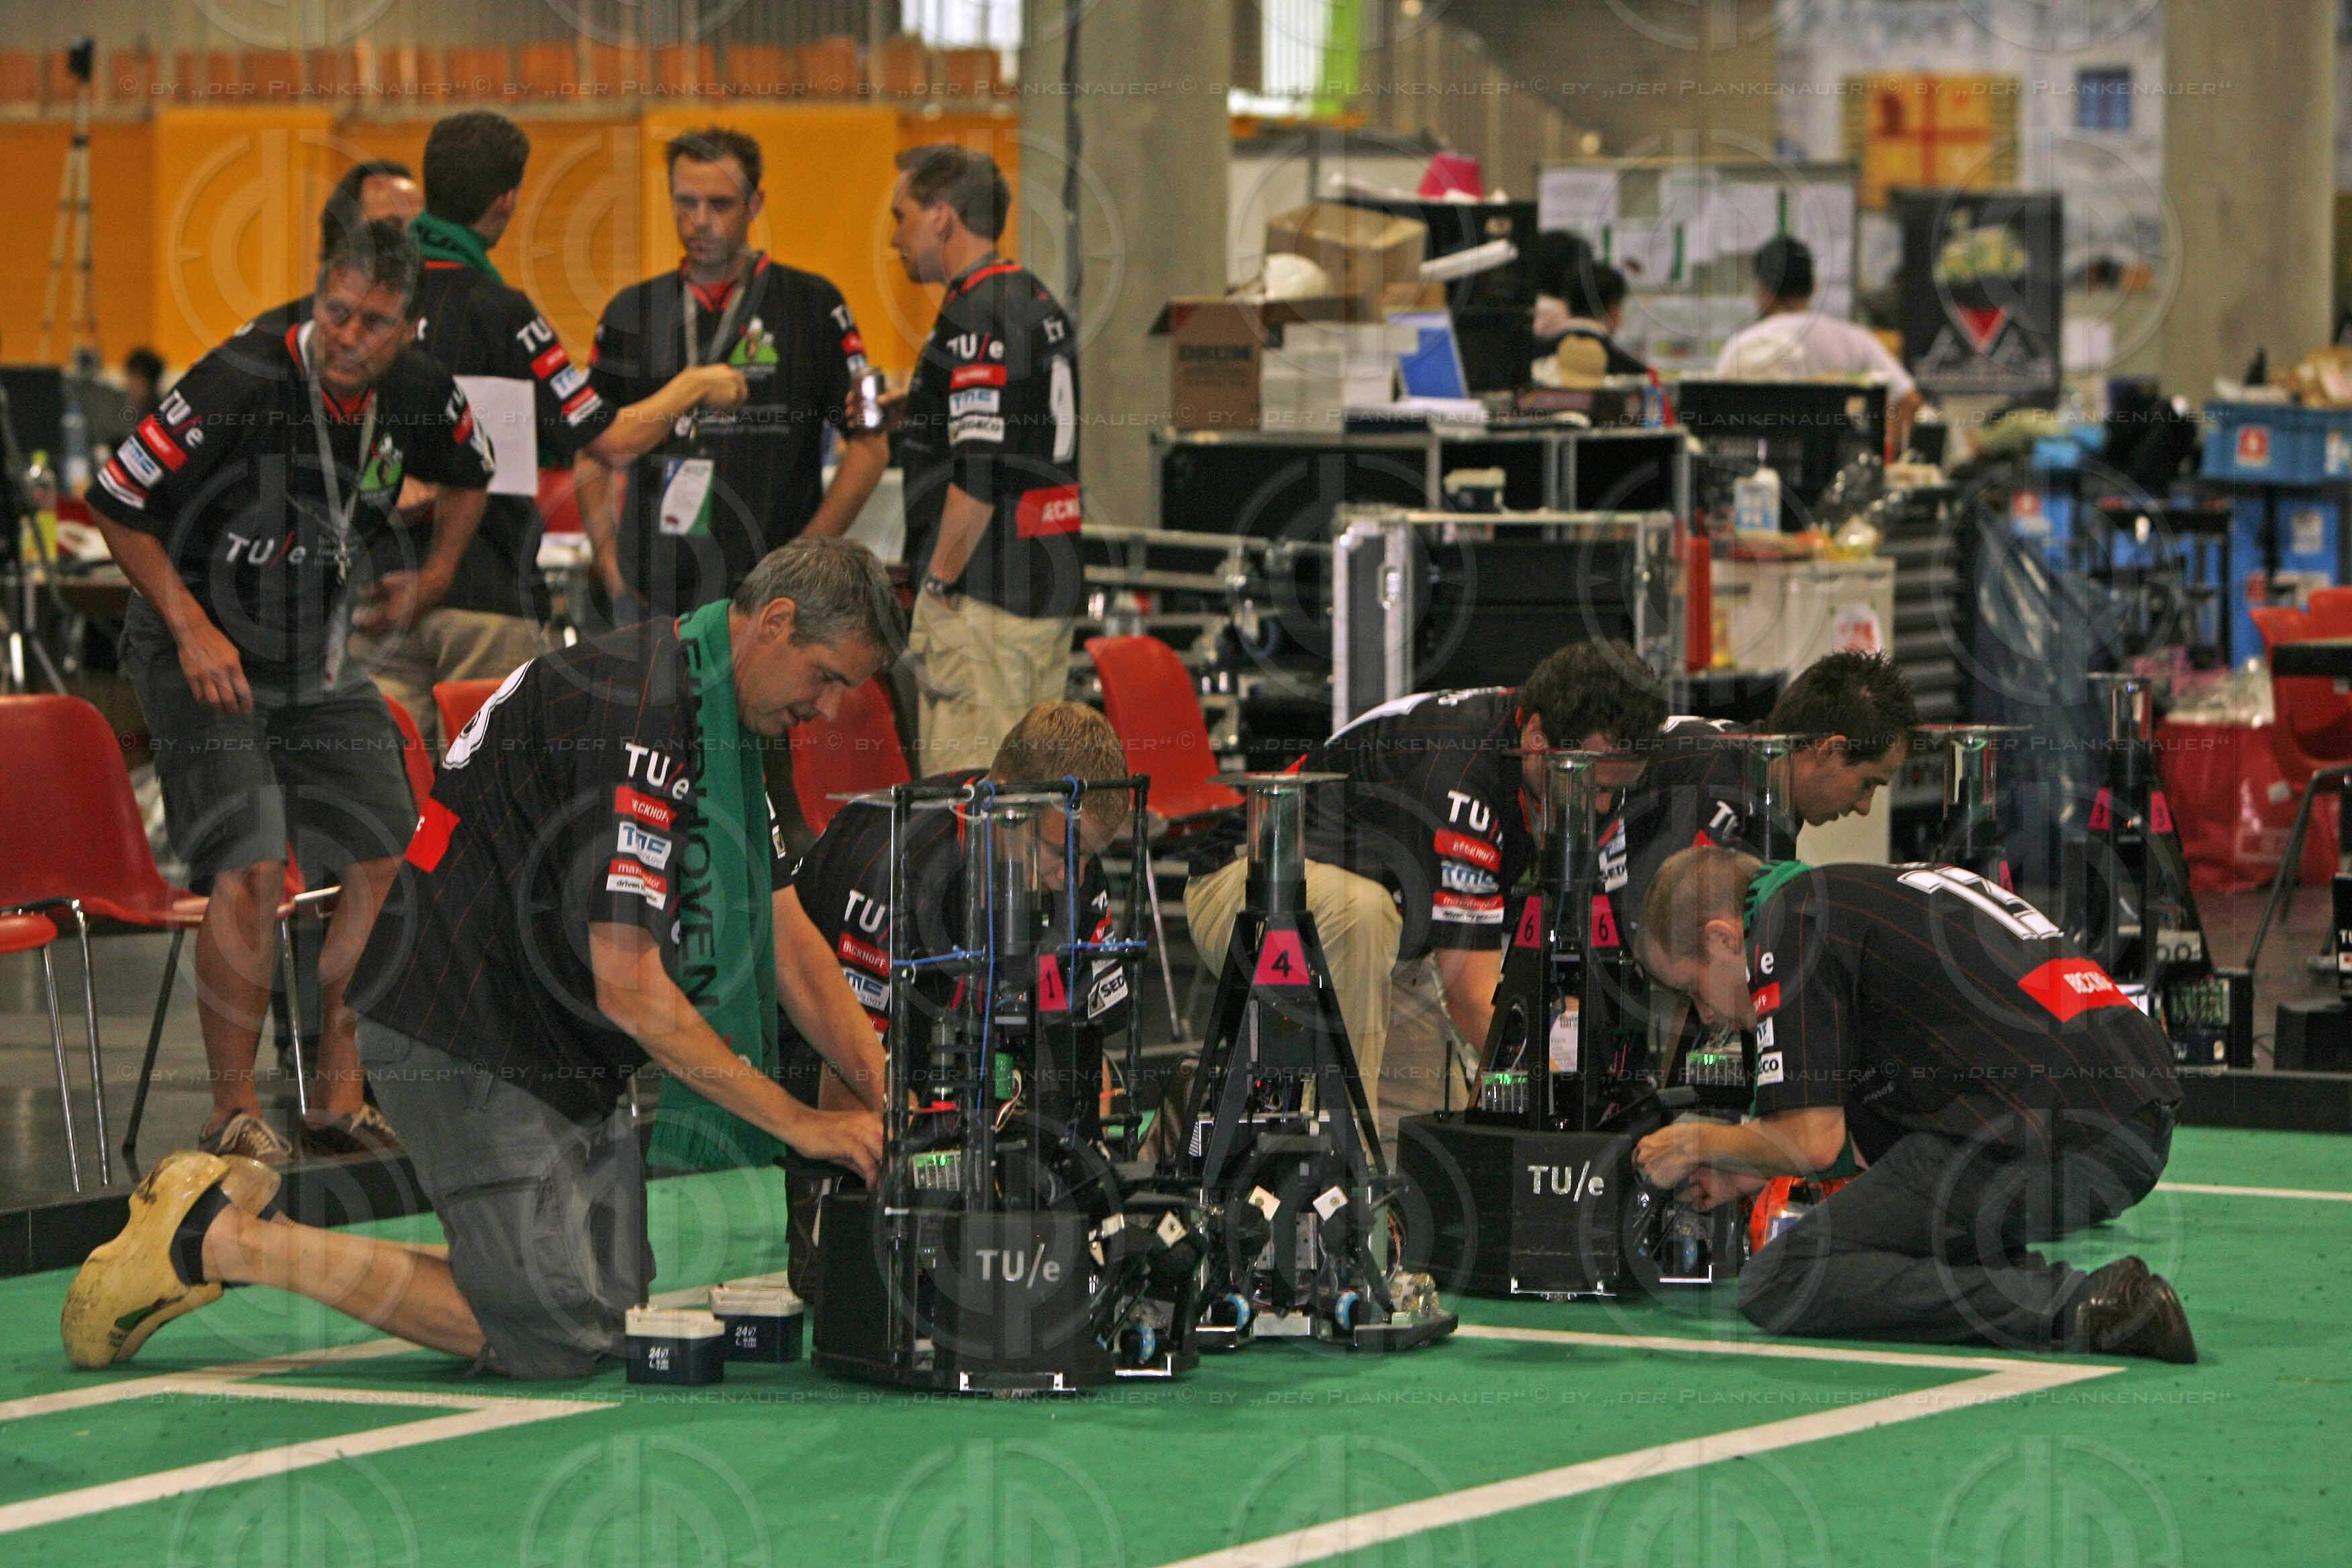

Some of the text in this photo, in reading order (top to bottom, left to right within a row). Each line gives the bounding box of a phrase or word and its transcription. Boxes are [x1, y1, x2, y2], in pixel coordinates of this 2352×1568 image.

[226, 528, 307, 570] TU/e
[624, 741, 690, 801] TU/e
[1523, 914, 1534, 941] 6
[1598, 914, 1610, 941] 6
[1271, 951, 1291, 978] 4
[1046, 971, 1055, 999] 1
[1527, 1160, 1605, 1203] TU/e
[975, 1243, 1061, 1289] TU/e
